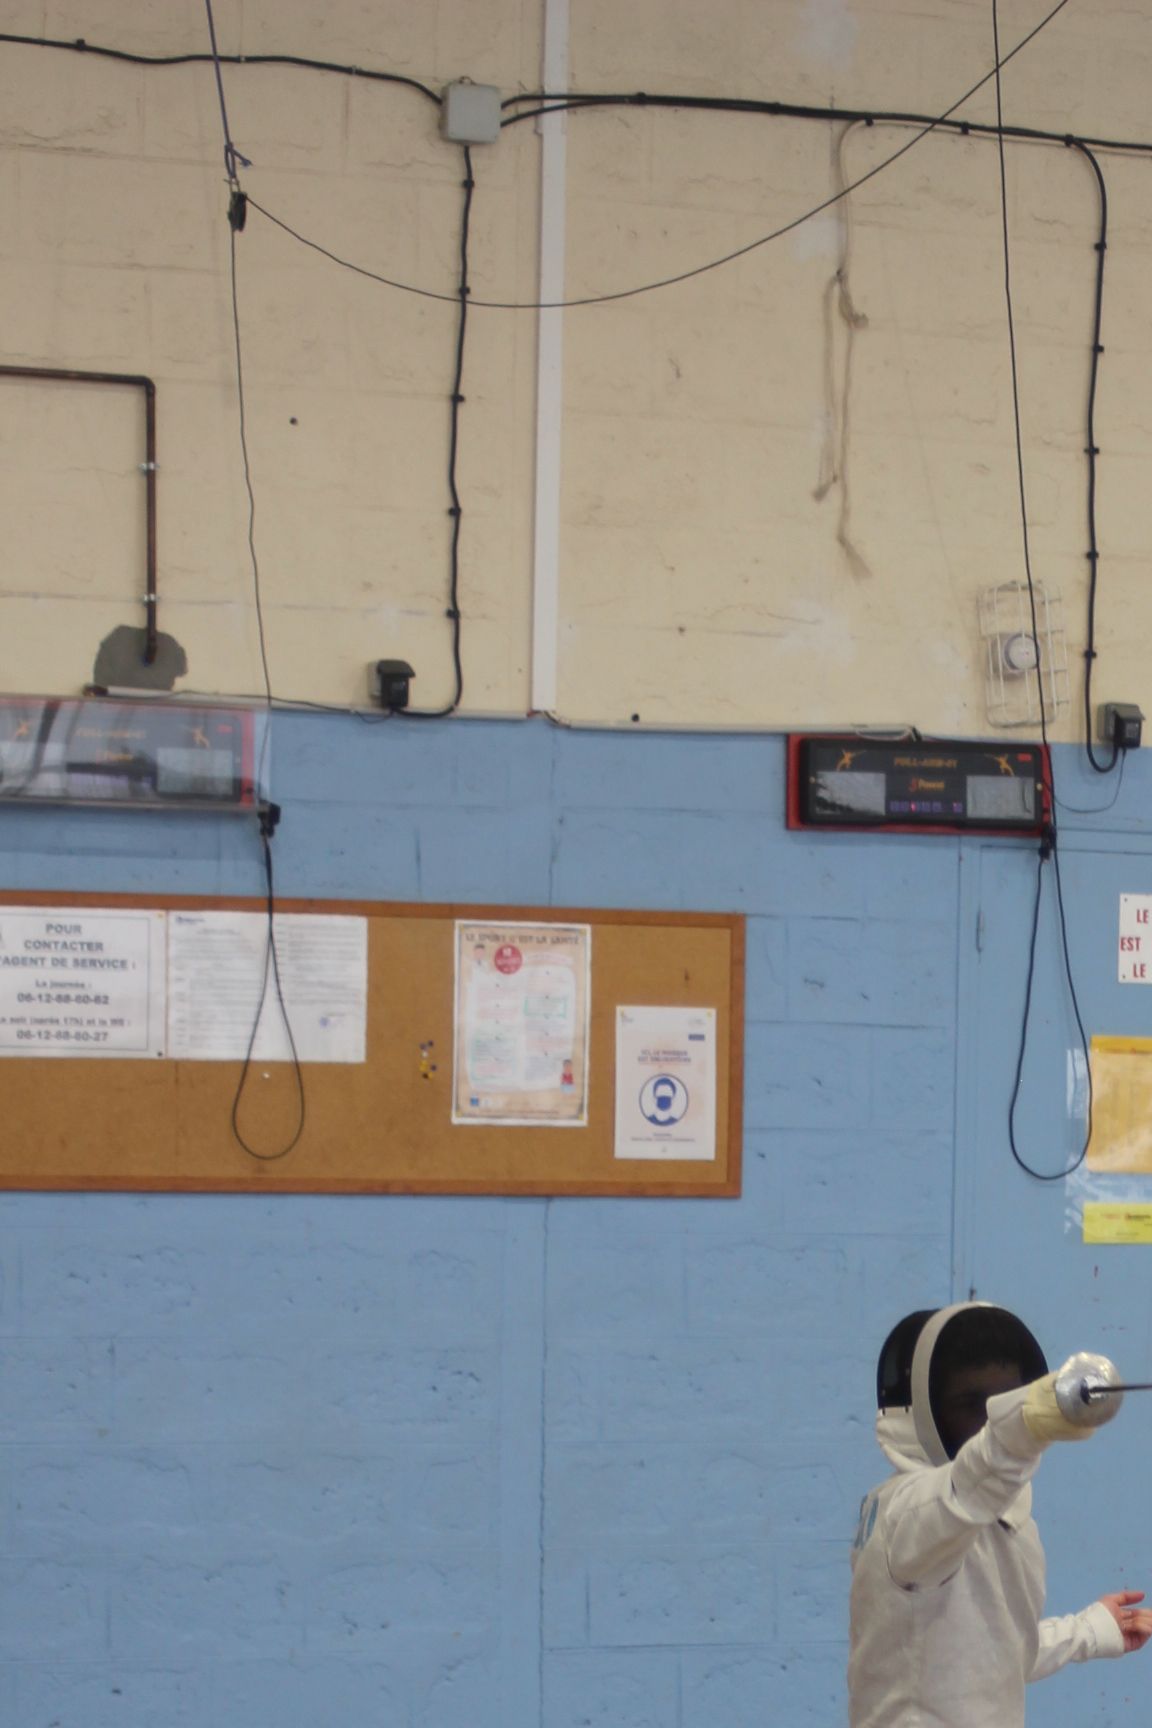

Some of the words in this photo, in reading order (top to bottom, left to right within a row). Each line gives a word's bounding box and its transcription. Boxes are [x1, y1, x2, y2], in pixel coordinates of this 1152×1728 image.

[1136, 909, 1149, 924] LE
[45, 923, 82, 934] POUR
[24, 940, 104, 951] CONTACTER
[1120, 937, 1141, 951] EST
[51, 956, 68, 968] DE
[72, 958, 128, 969] SERVICE
[1133, 963, 1146, 978] LE
